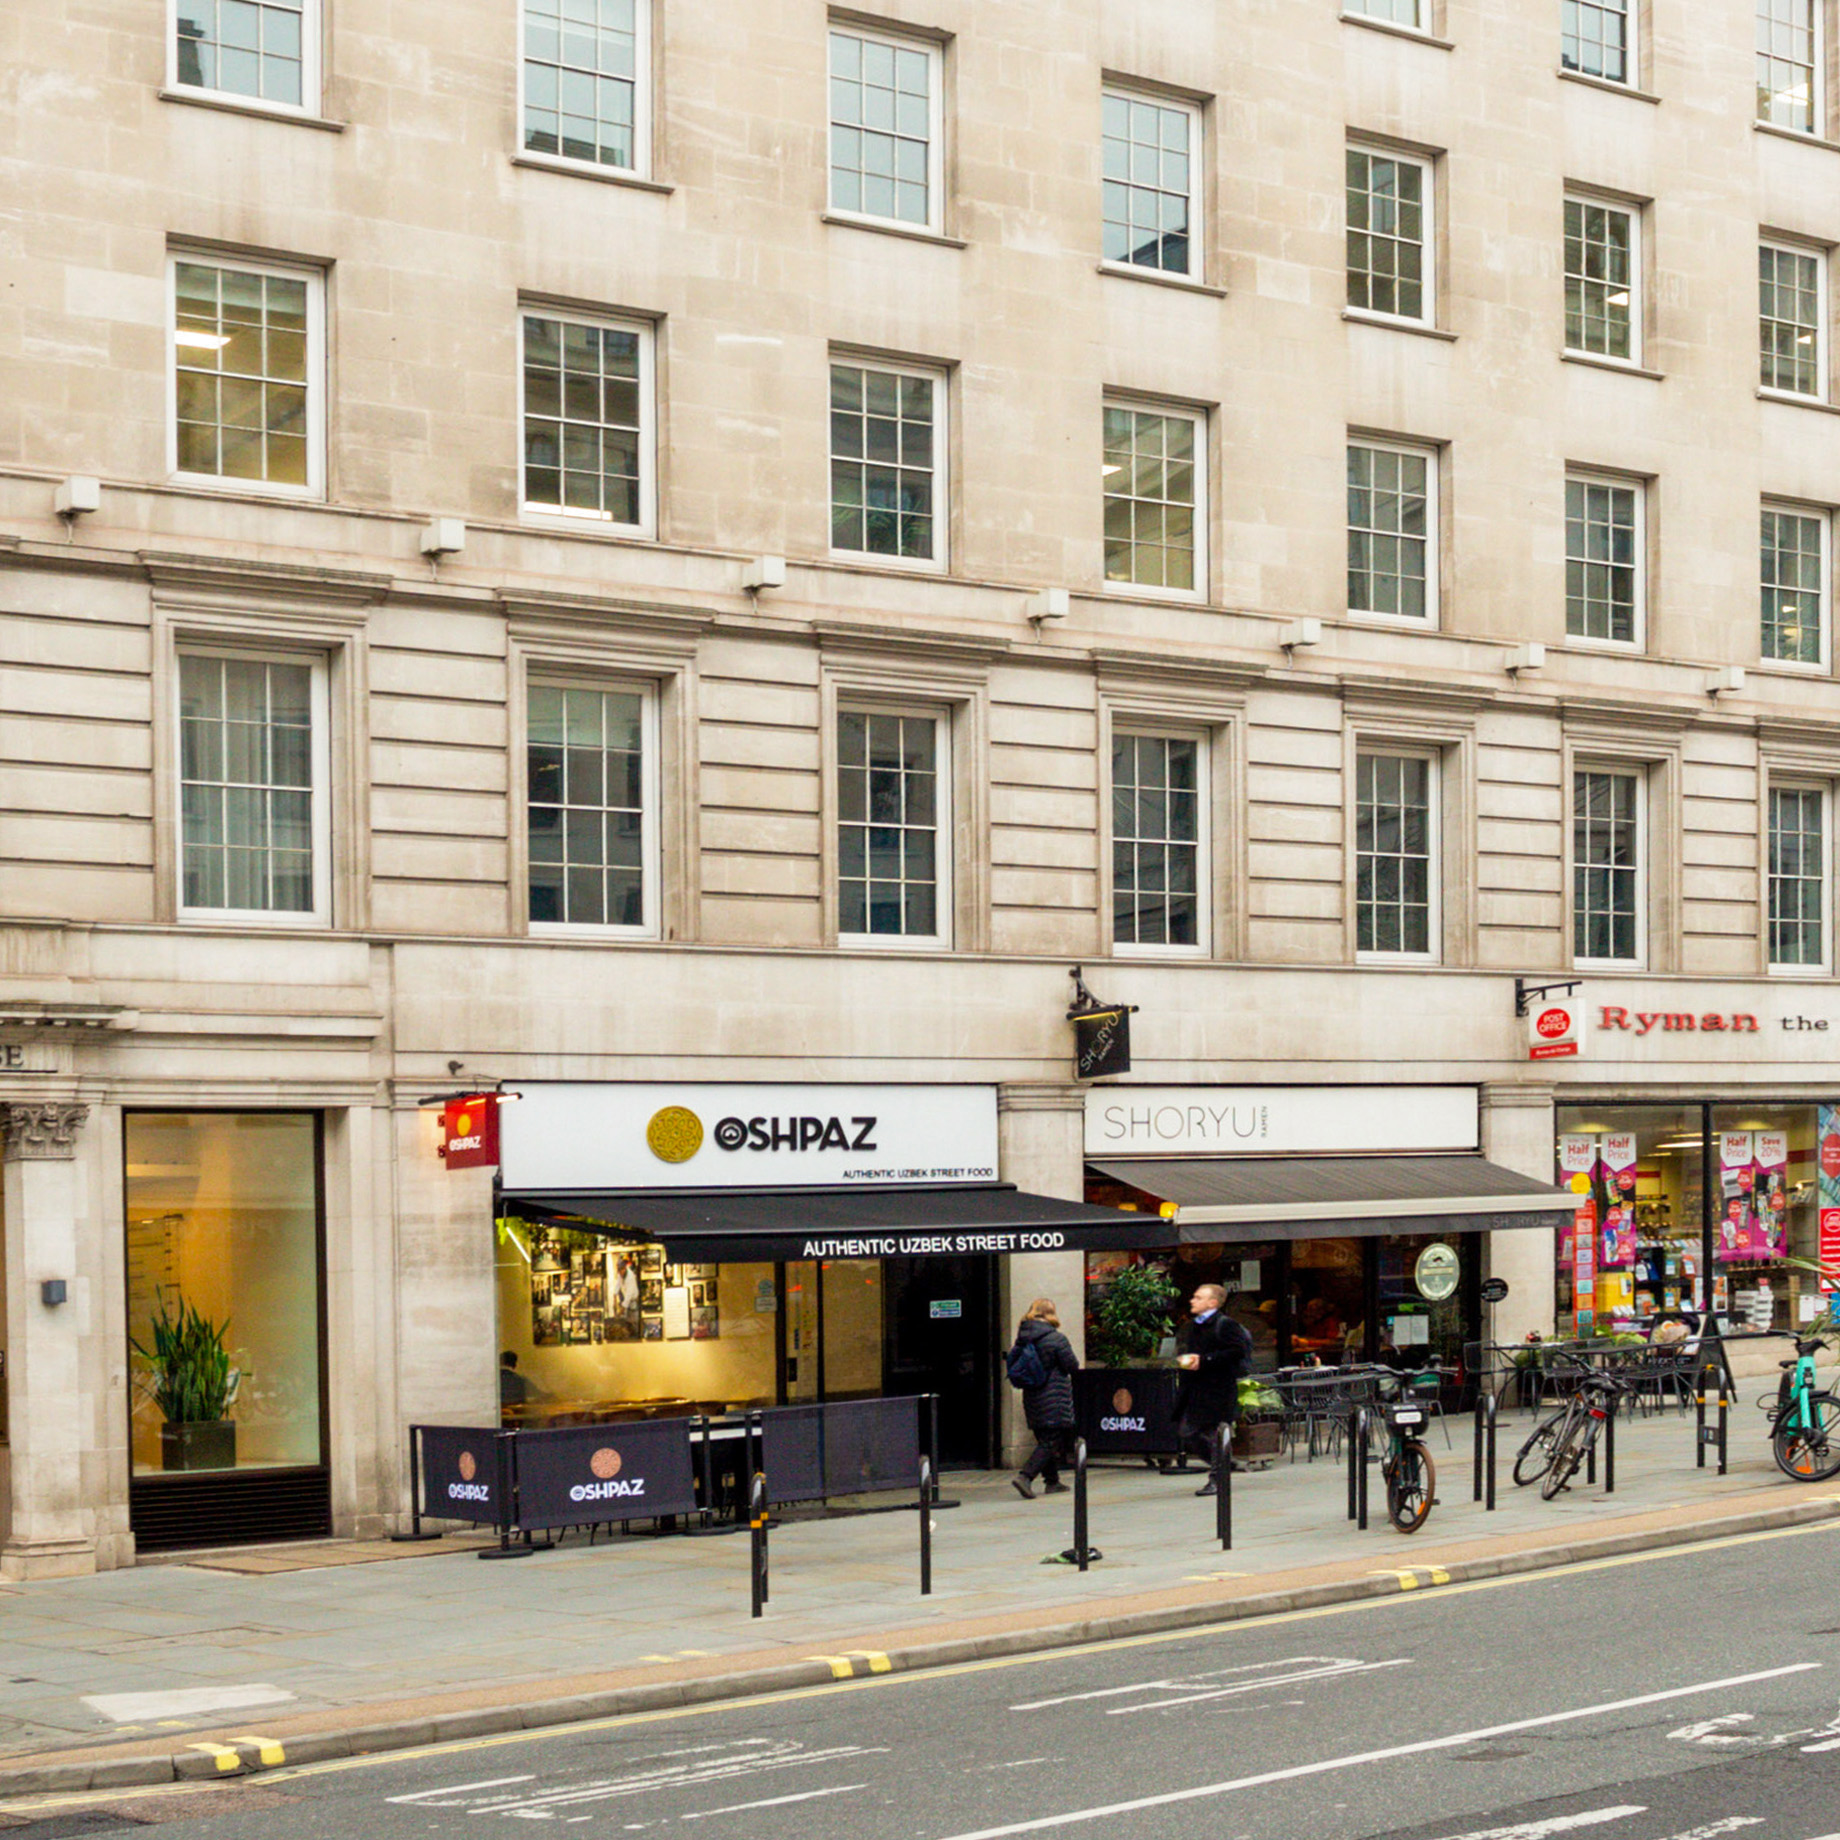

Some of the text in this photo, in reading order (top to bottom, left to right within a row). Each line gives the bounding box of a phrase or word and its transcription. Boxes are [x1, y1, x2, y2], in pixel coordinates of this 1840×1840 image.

[1544, 1013, 1564, 1023] POST
[1597, 1006, 1760, 1035] Ryman
[1781, 1016, 1829, 1031] the
[1539, 1021, 1566, 1033] OFFICE
[1104, 1106, 1256, 1139] SHORYU
[714, 1117, 877, 1152] OSHPAZ
[1608, 1137, 1630, 1148] Half
[1727, 1136, 1747, 1147] Half
[1761, 1137, 1780, 1145] Save
[1568, 1144, 1590, 1154] Half
[1608, 1149, 1630, 1159] Price
[1727, 1148, 1746, 1158] Price
[1761, 1147, 1782, 1157] 20%
[1567, 1156, 1590, 1166] Price
[843, 1167, 993, 1179] AUTHENTIC UZBEK STREET FOOD
[1492, 1215, 1540, 1228] SHRYU
[803, 1232, 1065, 1257] AUTHENTIC UZBEK STREET FOOD
[1100, 1416, 1146, 1431] OSHPAZ
[448, 1483, 490, 1501] OSHPAZ
[570, 1478, 645, 1502] OSHPAZ
